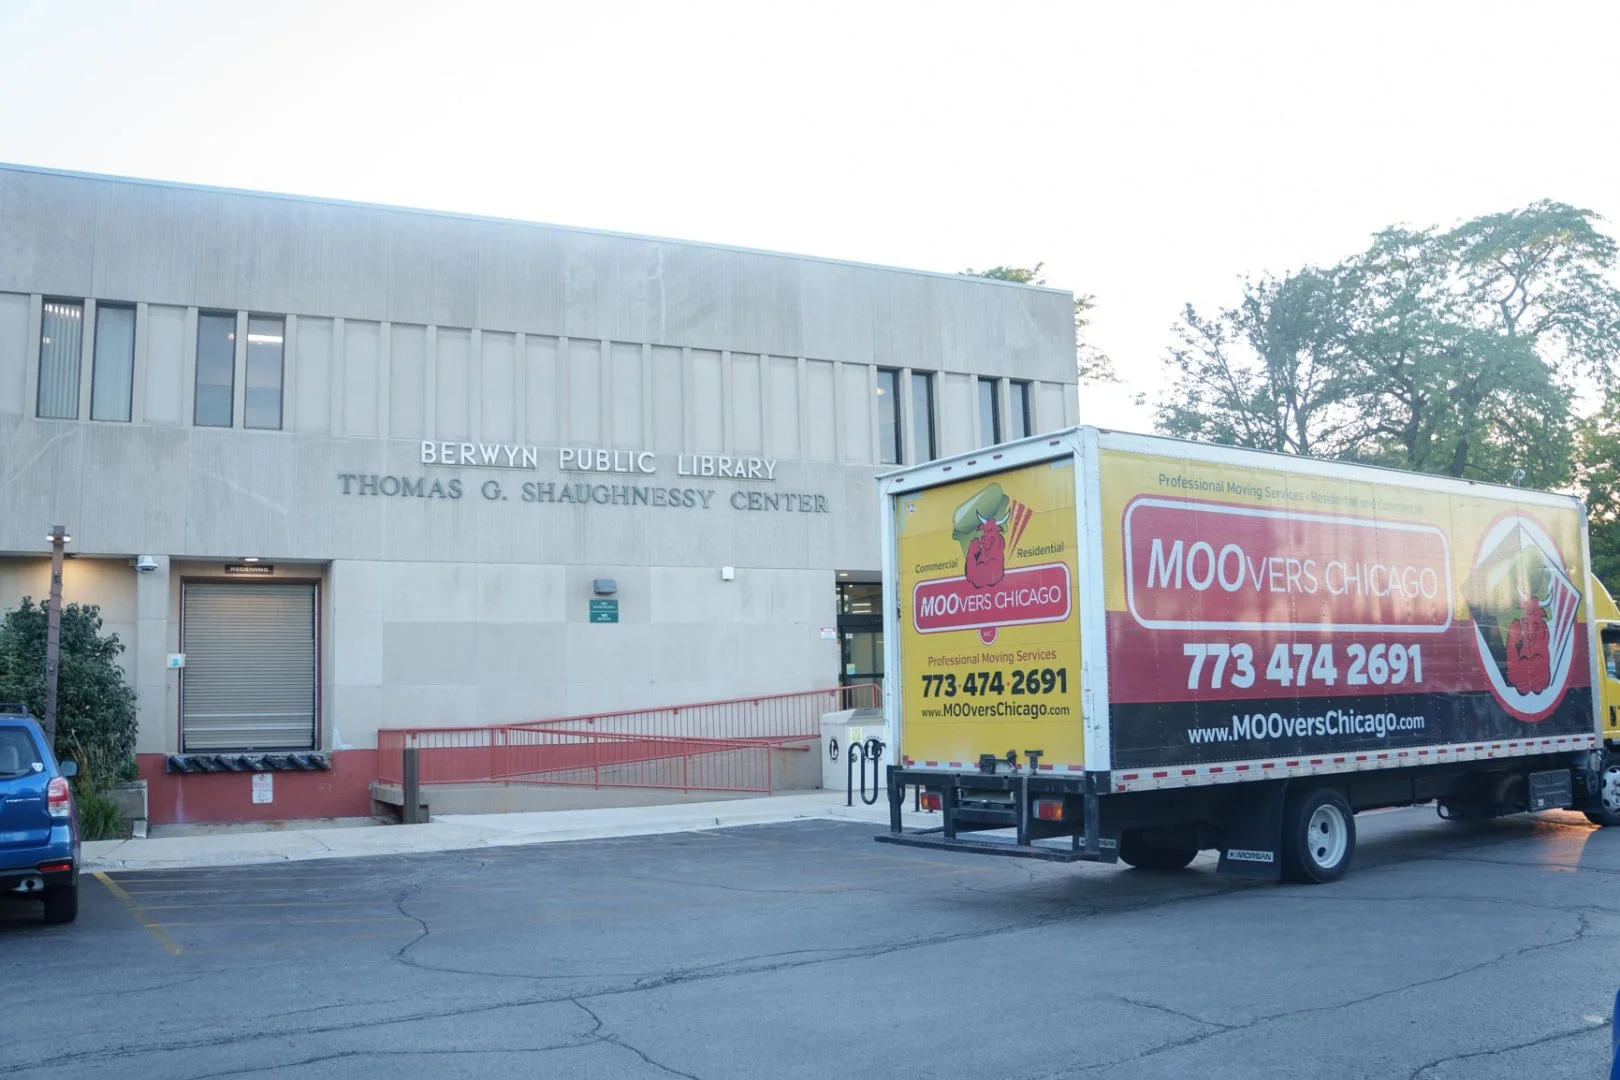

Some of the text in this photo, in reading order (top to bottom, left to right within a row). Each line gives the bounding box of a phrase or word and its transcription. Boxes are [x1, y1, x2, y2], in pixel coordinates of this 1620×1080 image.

[421, 440, 777, 479] BERWYN PUBLIC LIBRARY
[338, 473, 829, 514] THOMAS G. SHAUGHNESSY CENTER
[1158, 473, 1224, 493] Professional
[1227, 481, 1263, 500] Moving
[1264, 486, 1304, 501] Services
[1310, 491, 1359, 508] Residential
[1016, 542, 1065, 558] Residential
[915, 559, 959, 574] Commercial
[1325, 560, 1438, 599] CHICAGO
[994, 585, 1062, 609] CHICAGO
[928, 649, 1057, 667] Professional Moving Services
[1183, 642, 1423, 690] 773 474 2691
[921, 701, 1070, 720] www.MOOversChicago.com
[1187, 708, 1425, 744] www.MOOversChicago.com
[1236, 851, 1272, 861] MORGAN
